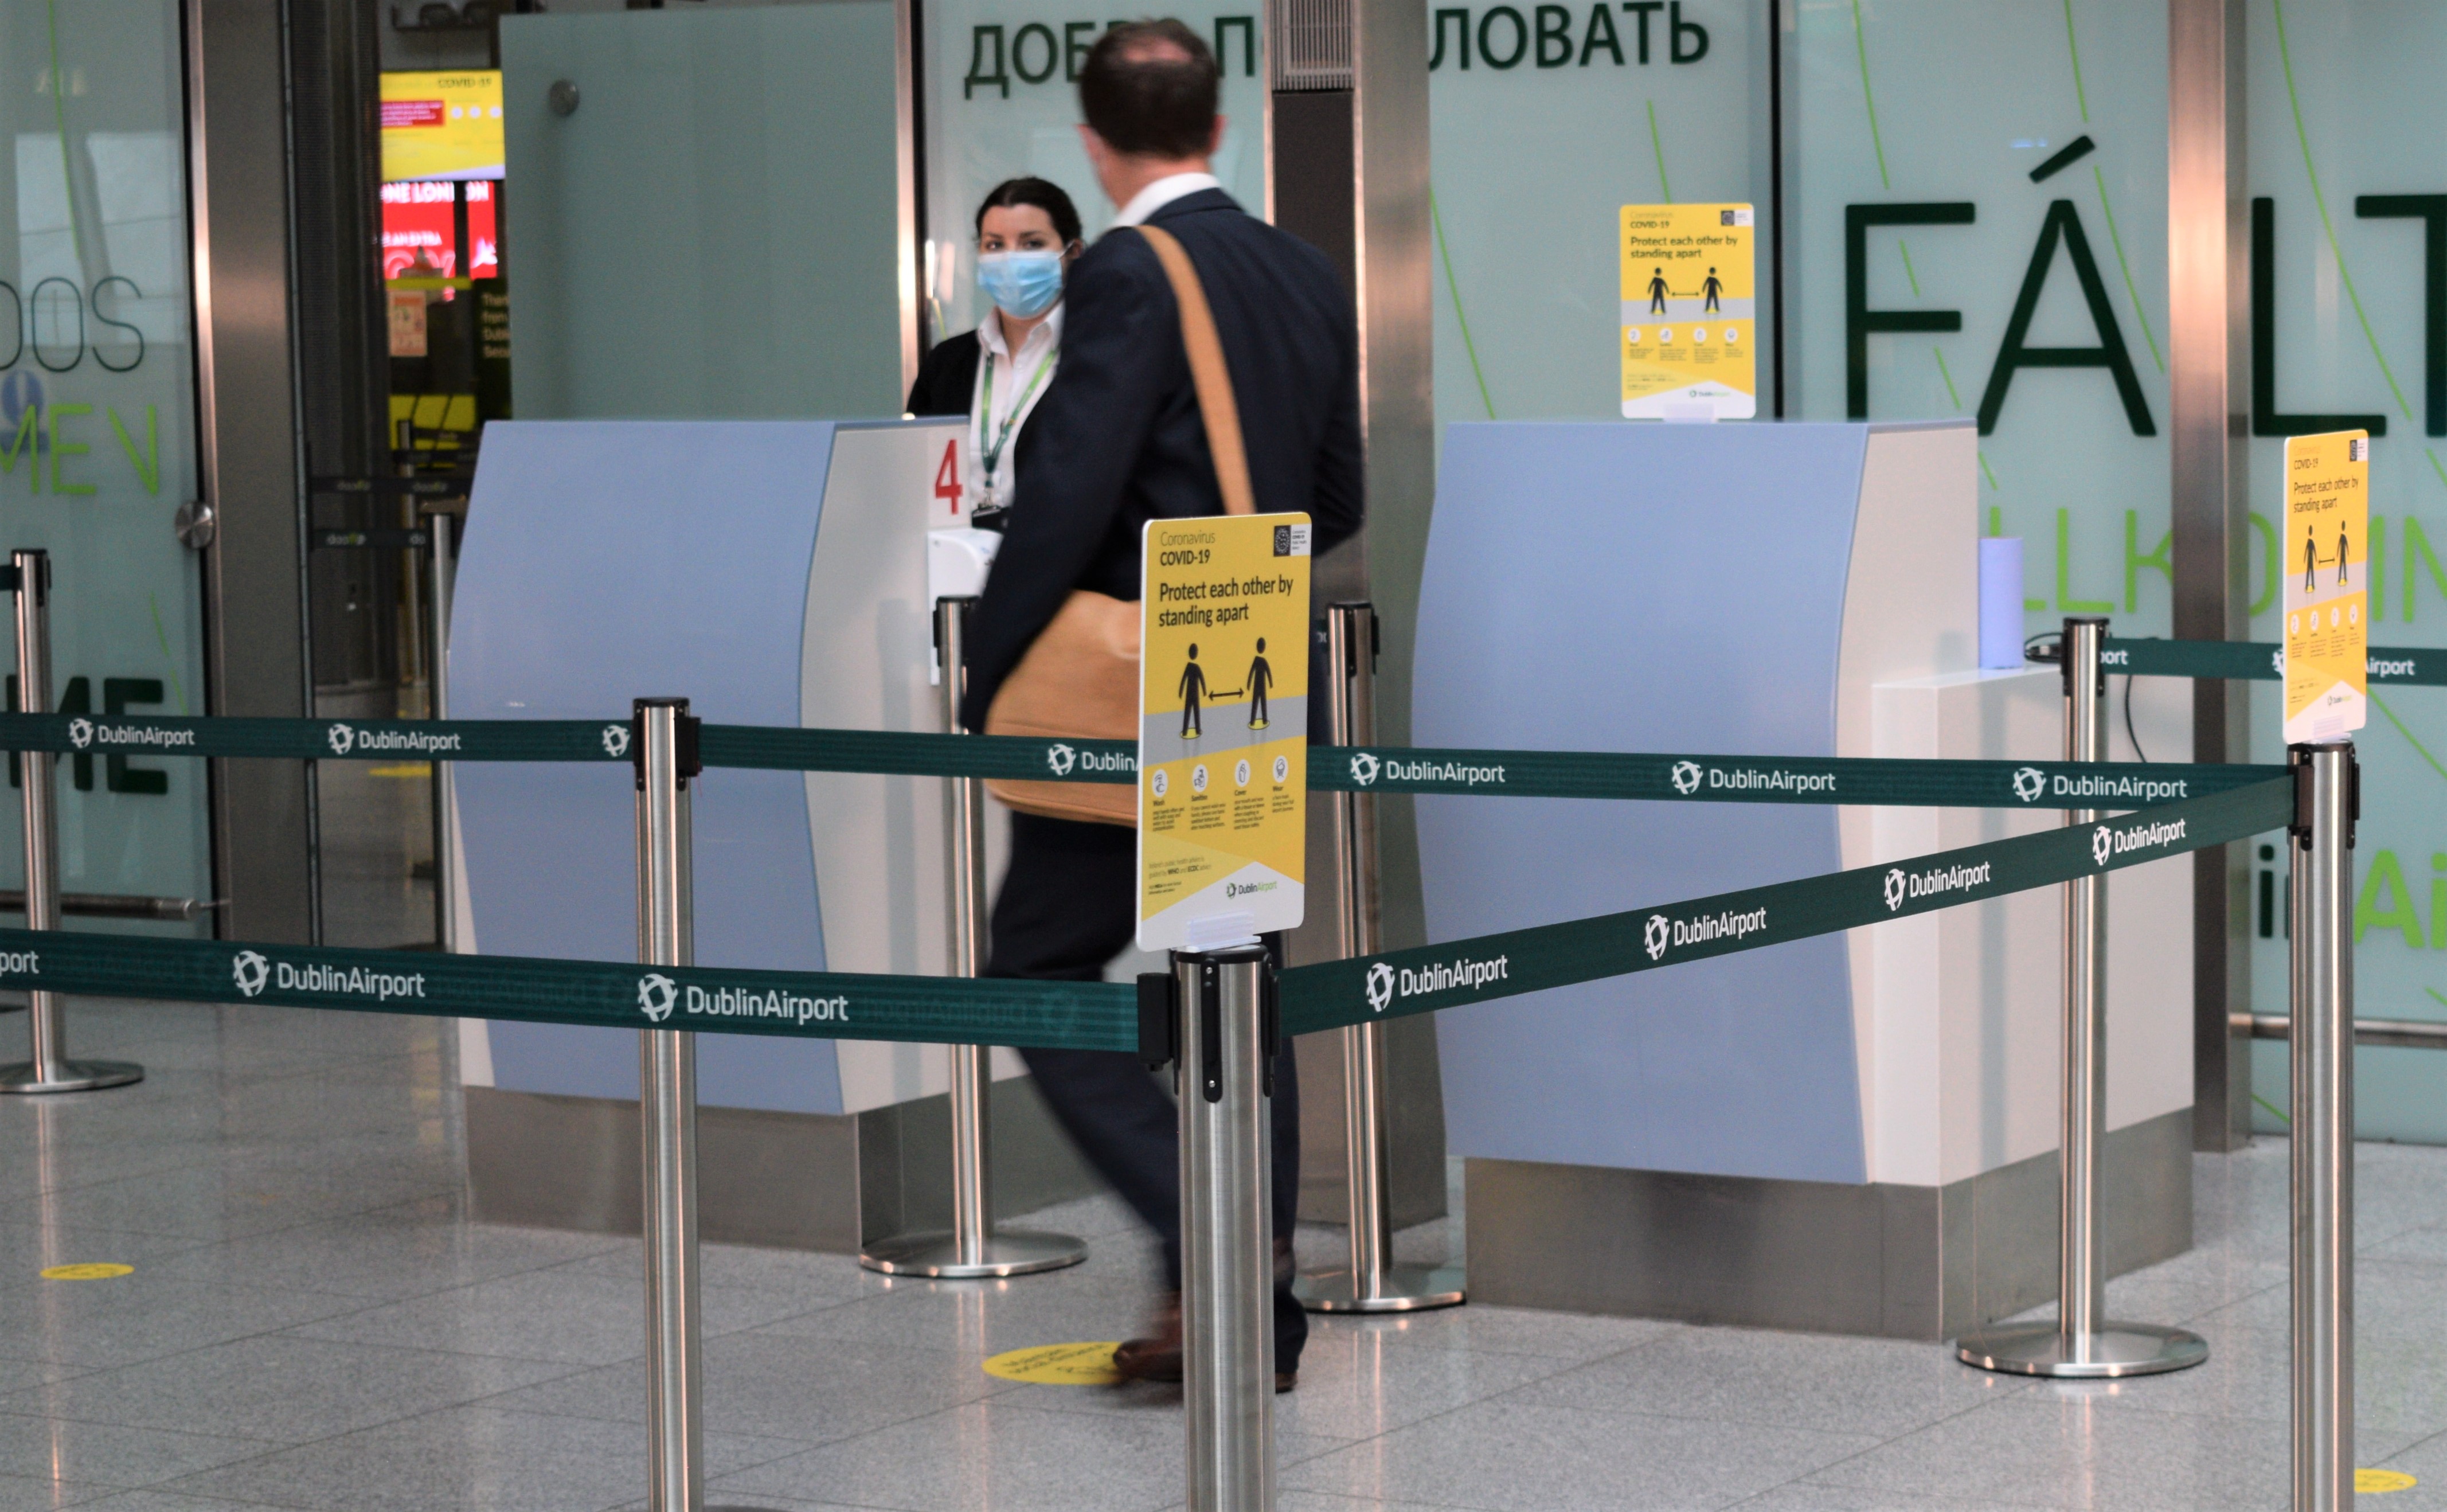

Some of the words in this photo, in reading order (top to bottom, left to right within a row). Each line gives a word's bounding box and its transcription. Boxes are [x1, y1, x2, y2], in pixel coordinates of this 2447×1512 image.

[1631, 220, 1670, 229] COVID-19
[1631, 237, 1667, 246] Protect
[1670, 236, 1693, 246] each
[1697, 236, 1723, 245] other
[1726, 236, 1738, 247] by
[1631, 249, 1673, 260] standing
[1676, 249, 1702, 259] apart
[2294, 458, 2319, 470] COVID-19
[935, 439, 963, 515] 4
[2294, 482, 2317, 495] Protect
[2319, 479, 2332, 492] each
[2334, 477, 2350, 491] other
[2352, 476, 2359, 490] by
[2294, 498, 2320, 513] standing
[2322, 497, 2337, 511] apart
[1160, 530, 1215, 546] Coronavirus
[1160, 549, 1210, 566] COVID-19
[1160, 581, 1206, 601] Protect
[1210, 577, 1238, 597] each
[1242, 576, 1275, 595] other
[1279, 574, 1293, 596] by
[1159, 605, 1213, 627] standing
[1216, 603, 1249, 626] apart
[98, 725, 195, 748] DublinAirport
[359, 730, 462, 752] DublinAirport
[1081, 751, 1139, 772] Dublin
[1386, 760, 1506, 786] DublinAirport
[1710, 768, 1836, 795] DublinAirport
[2054, 776, 2187, 802] DublinAirport
[2114, 818, 2186, 854] DublinAirport
[1238, 881, 1277, 895] DublinAirport
[1910, 861, 1991, 898] DublinAirport
[1674, 906, 1766, 947] DublinAirport
[0, 950, 39, 977] port
[277, 962, 425, 1001] DublinAirport
[1400, 955, 1508, 997] DublinAirport
[687, 985, 850, 1025] DublinAirport
